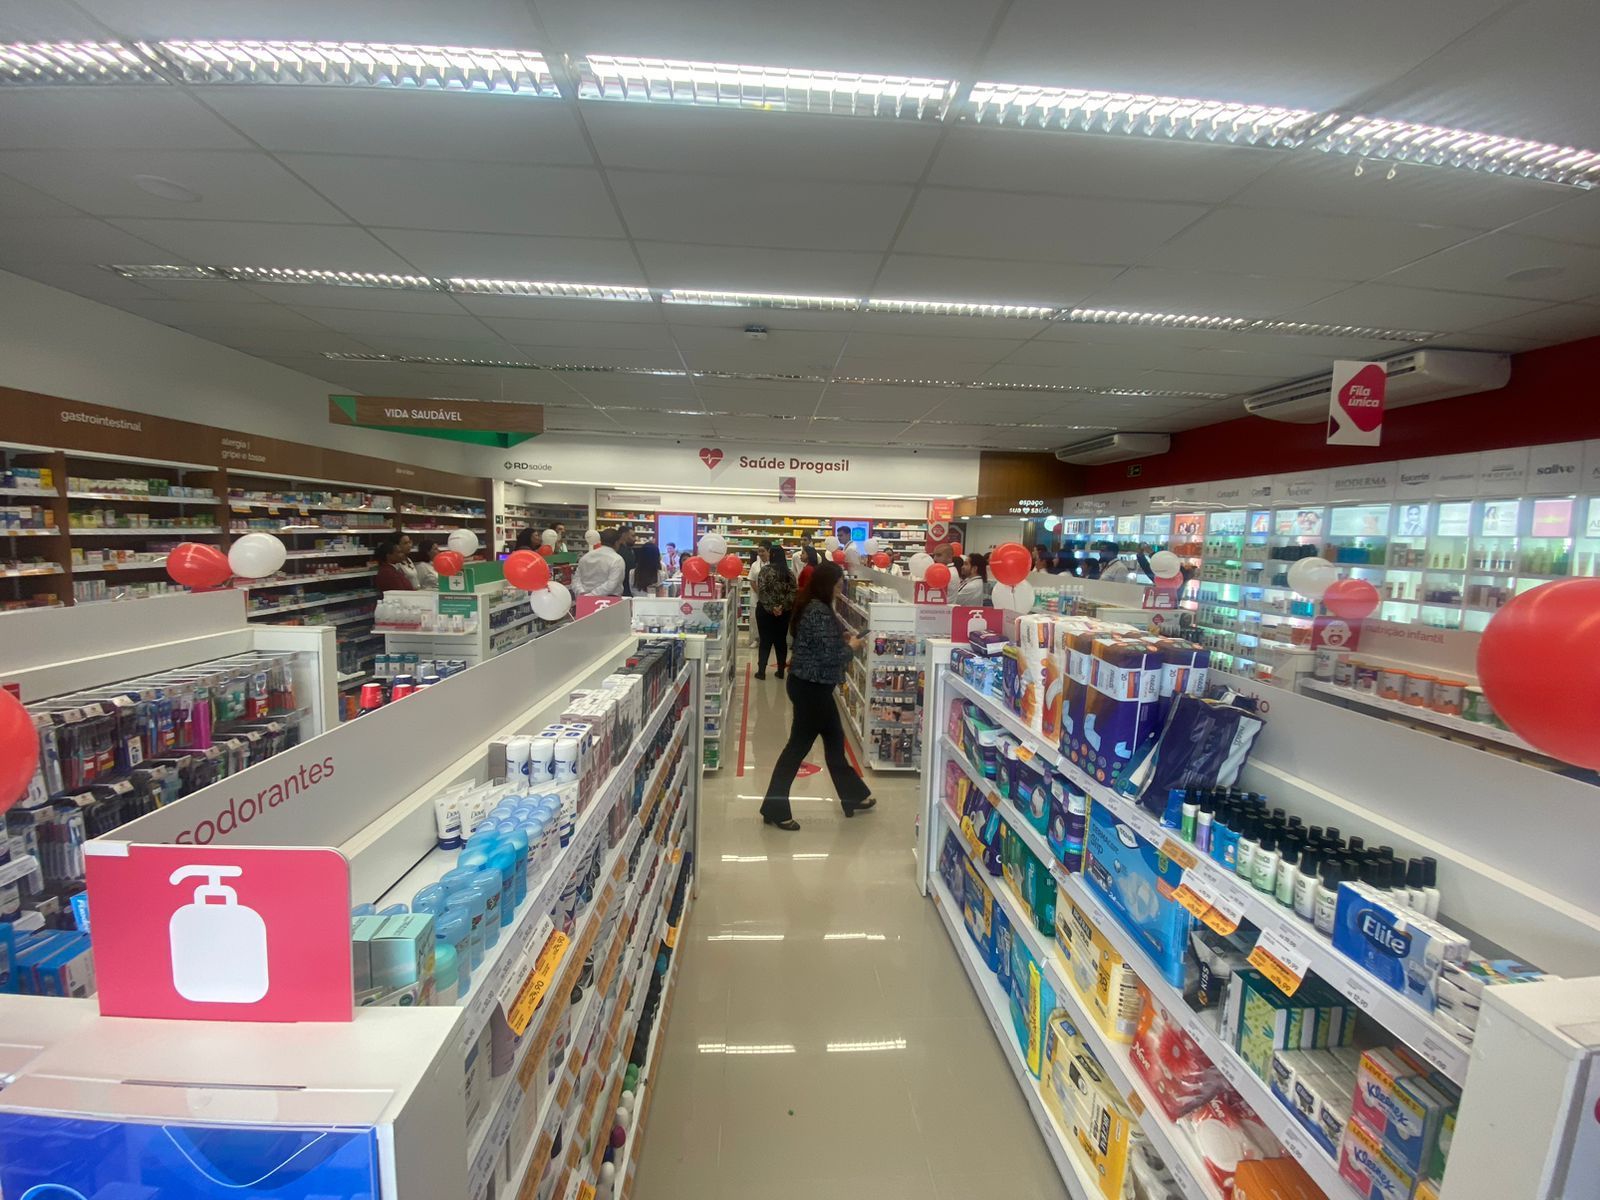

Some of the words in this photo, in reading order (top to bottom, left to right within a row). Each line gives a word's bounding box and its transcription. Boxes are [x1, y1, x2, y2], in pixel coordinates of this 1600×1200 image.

[1349, 385, 1371, 396] Fila
[1347, 396, 1380, 407] única
[60, 410, 142, 432] gastrointestinal
[384, 408, 409, 418] VIDA
[410, 408, 463, 421] SAUDÁVEL
[221, 449, 241, 463] gripe
[739, 455, 785, 470] Saúde
[789, 457, 850, 474] Drogasil
[1335, 476, 1387, 488] BIODERMA
[1019, 499, 1044, 508] espaço
[1406, 629, 1445, 644] infantil
[1148, 674, 1156, 694] needs
[1233, 726, 1245, 746] needs
[160, 756, 336, 845] sodorantes
[1362, 915, 1406, 955] Elite
[1200, 966, 1209, 991] KISS
[1132, 1041, 1150, 1071] Neve
[1210, 1095, 1226, 1119] Neve
[1366, 1081, 1409, 1127] Kleenex
[1353, 1146, 1396, 1194] Kleenex
